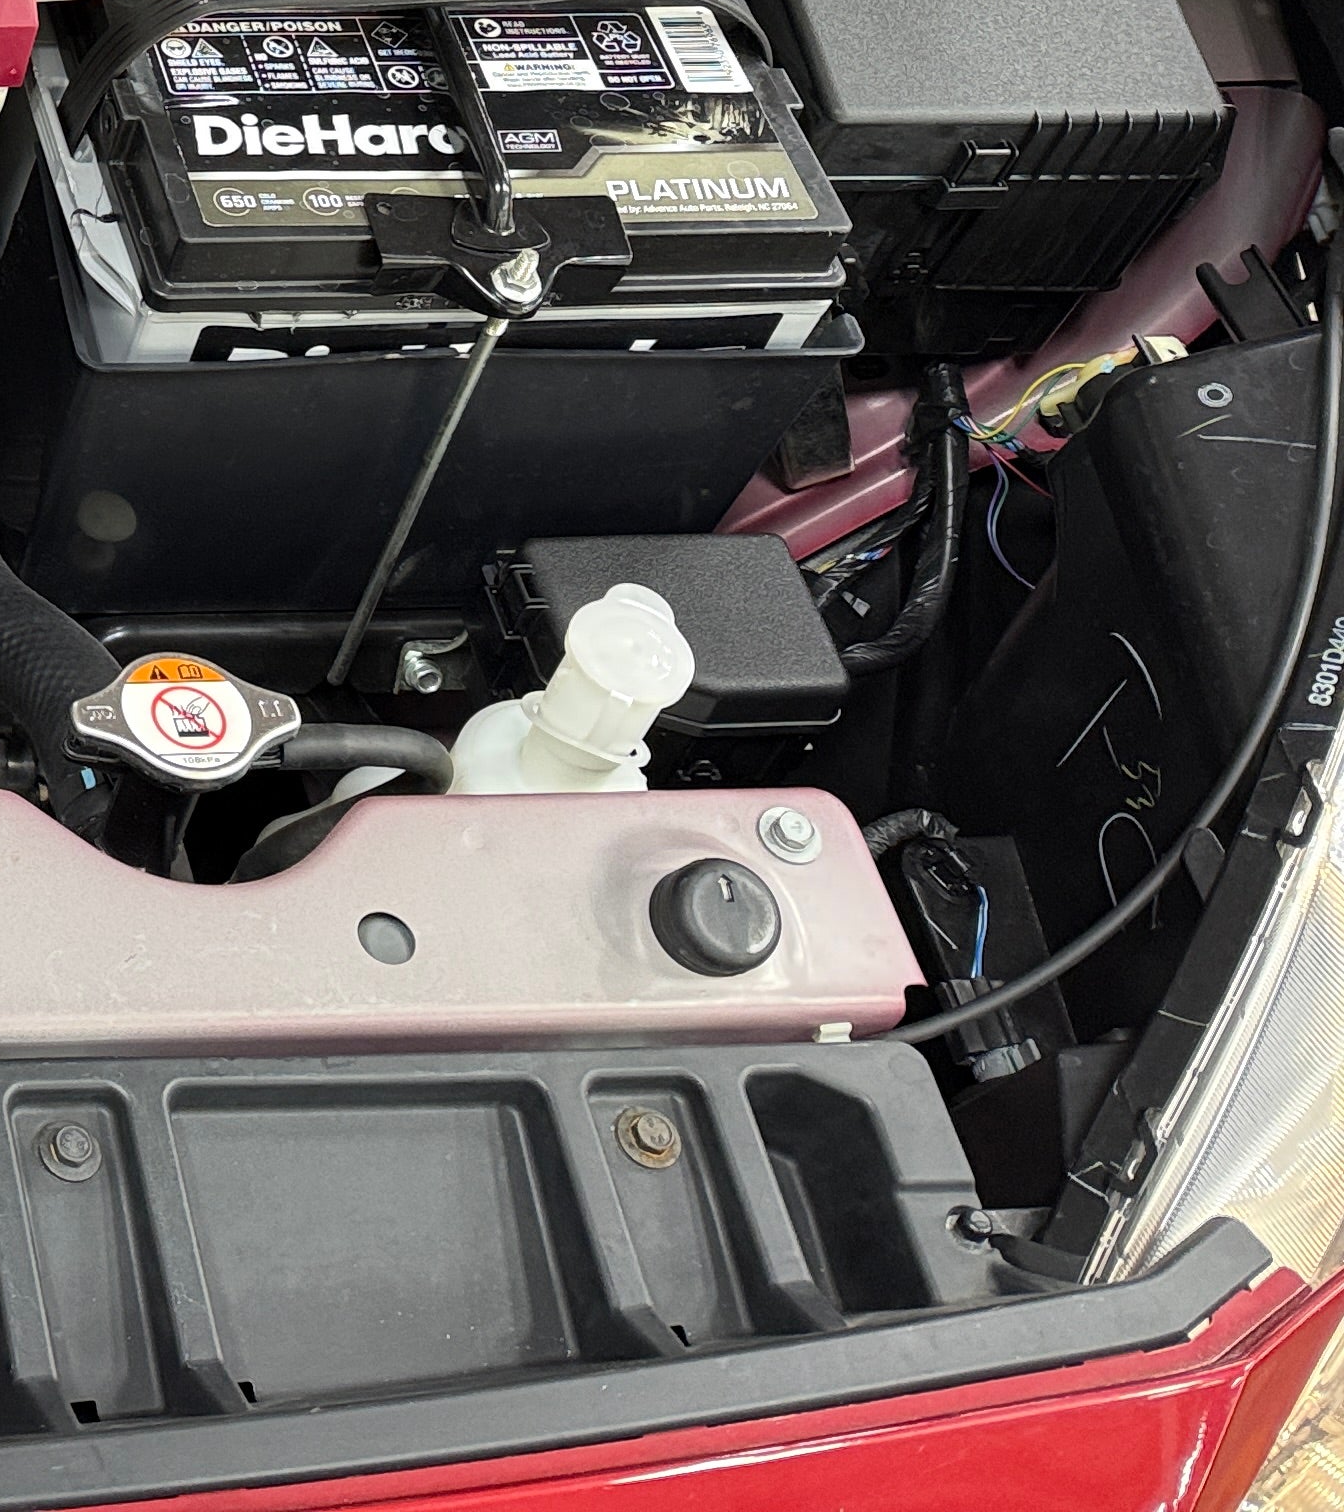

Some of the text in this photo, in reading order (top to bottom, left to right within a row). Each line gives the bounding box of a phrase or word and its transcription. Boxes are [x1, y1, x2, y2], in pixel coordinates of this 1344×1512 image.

[188, 20, 343, 33] DANGER/POISON
[482, 42, 578, 53] NON-SPILLABLE
[504, 132, 555, 143] AGM
[605, 177, 790, 201] PLATINUM
[219, 195, 257, 208] 650
[308, 194, 344, 208] 100
